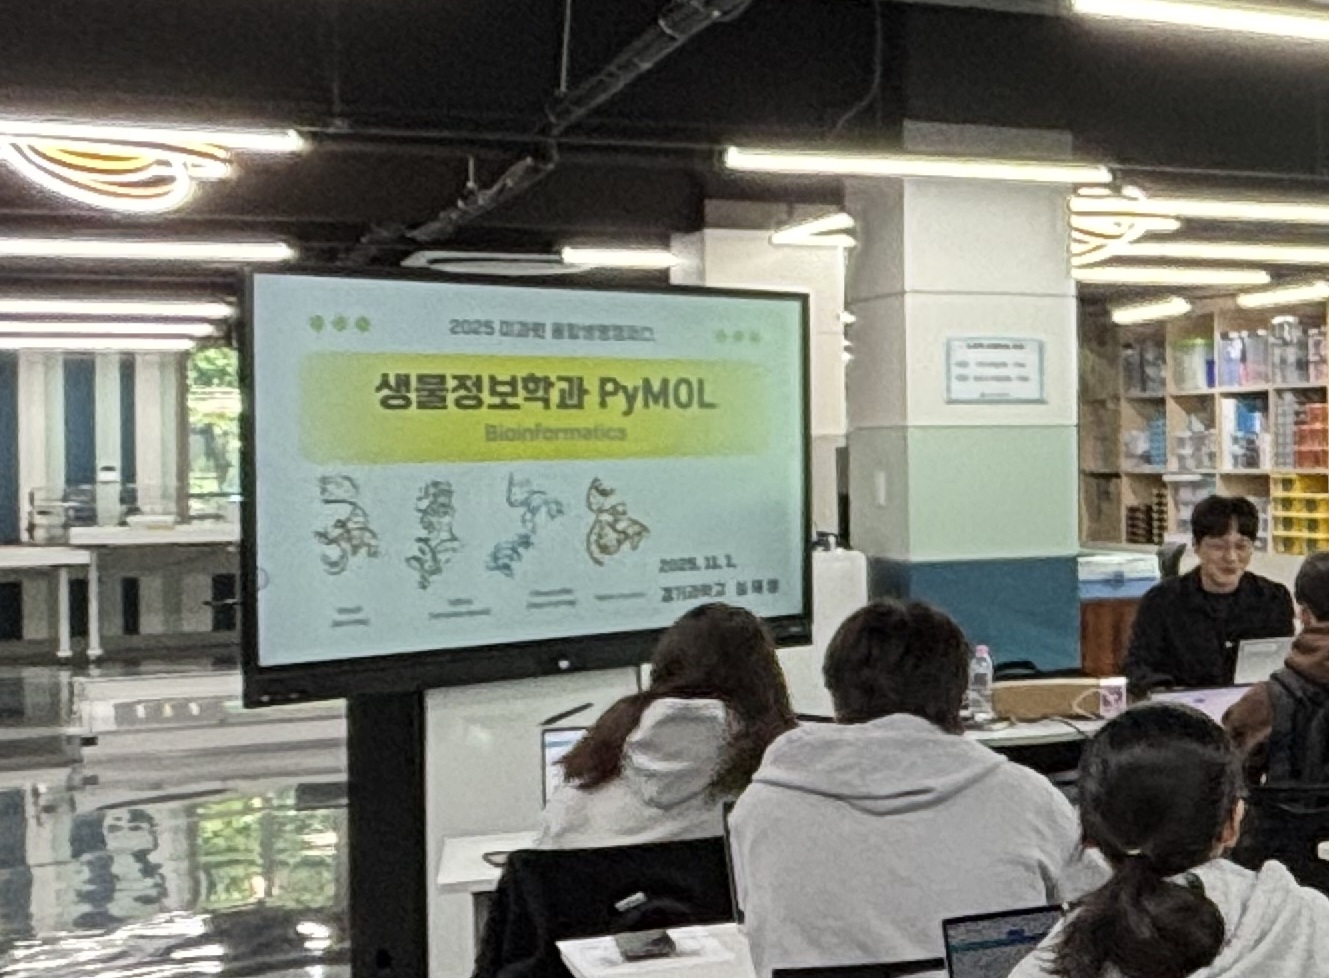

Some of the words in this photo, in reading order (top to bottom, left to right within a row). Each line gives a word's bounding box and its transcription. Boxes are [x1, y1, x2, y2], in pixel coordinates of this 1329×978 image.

[450, 319, 494, 335] 2025
[374, 372, 590, 410] 생물정보학과
[599, 376, 718, 416] PyMOL
[484, 423, 628, 443] Bioinformatics
